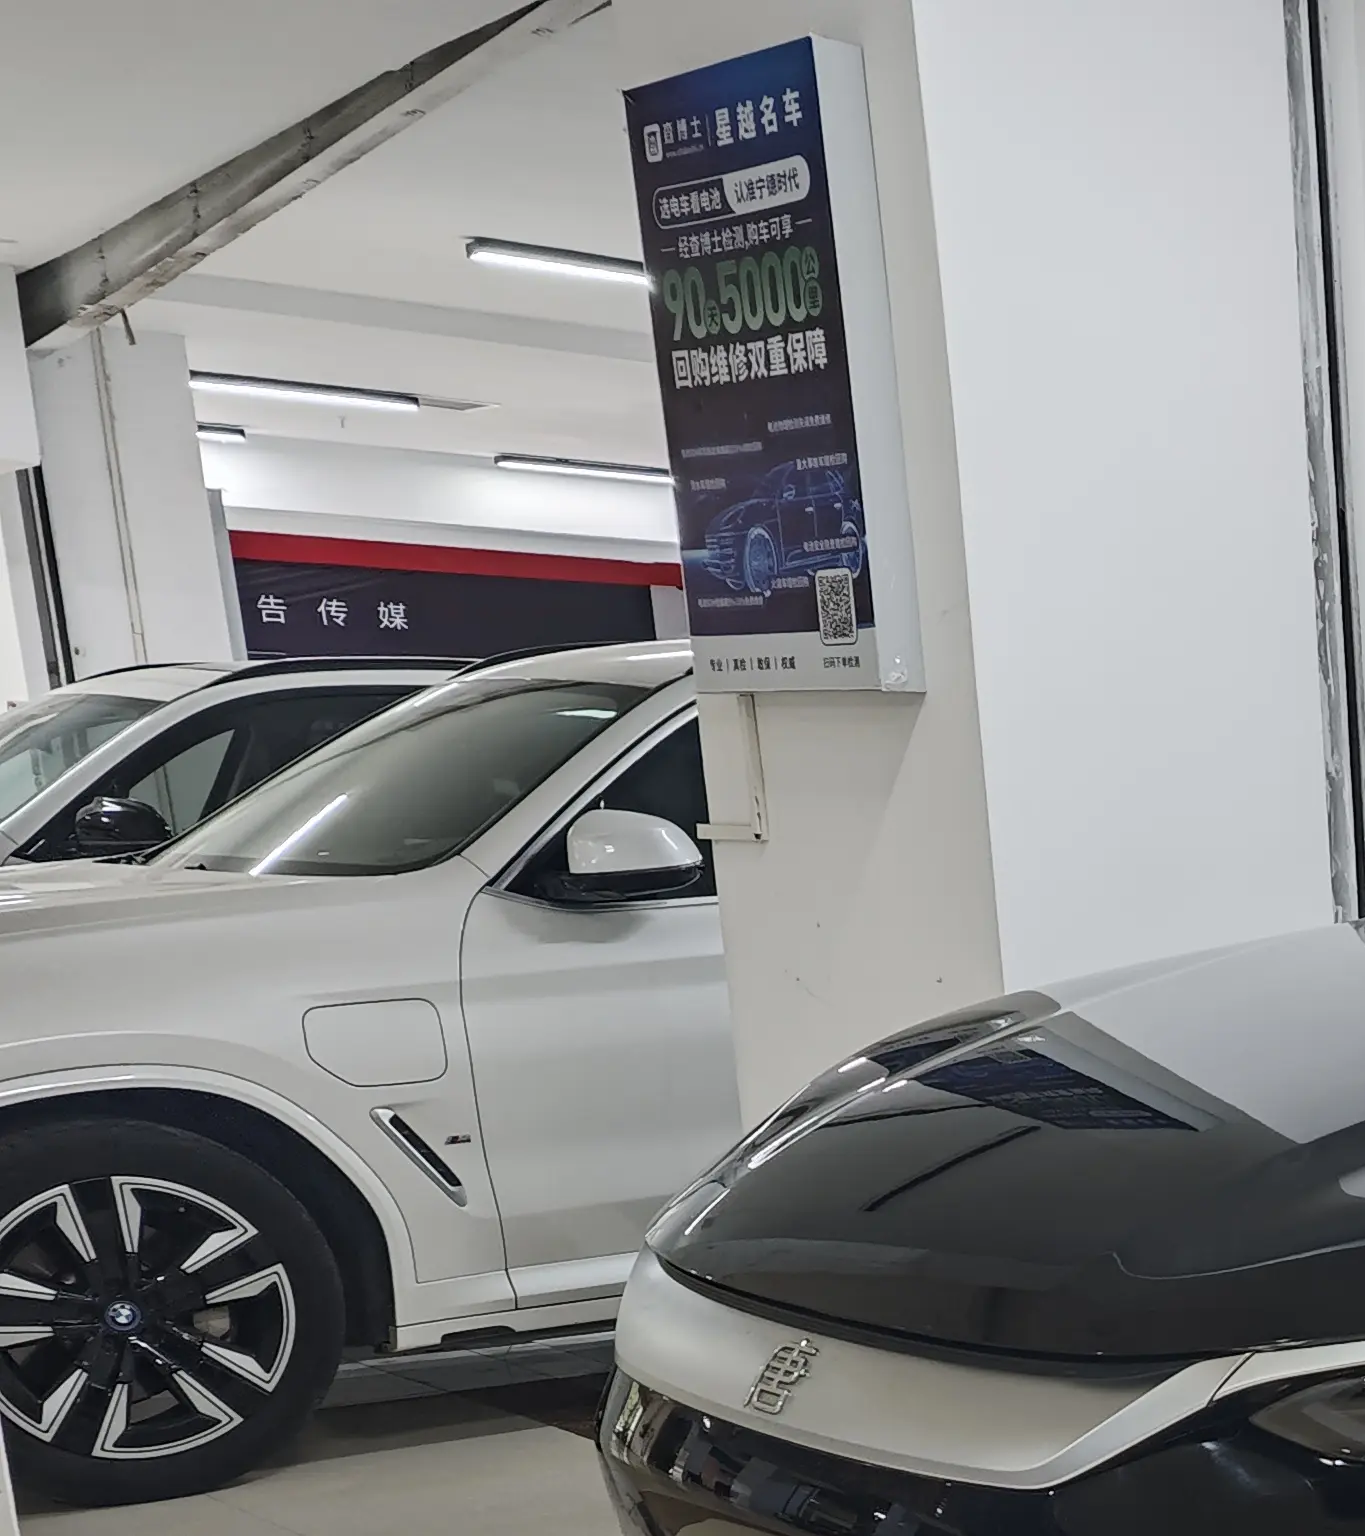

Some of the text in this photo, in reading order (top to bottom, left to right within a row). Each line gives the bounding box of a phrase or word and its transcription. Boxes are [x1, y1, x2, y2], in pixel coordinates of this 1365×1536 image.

[715, 87, 803, 147] 星越名车
[658, 167, 800, 219] 选电车看电池 认准宁德时代
[671, 327, 828, 389] 回购维修双重保障
[743, 1338, 819, 1415] 唐
